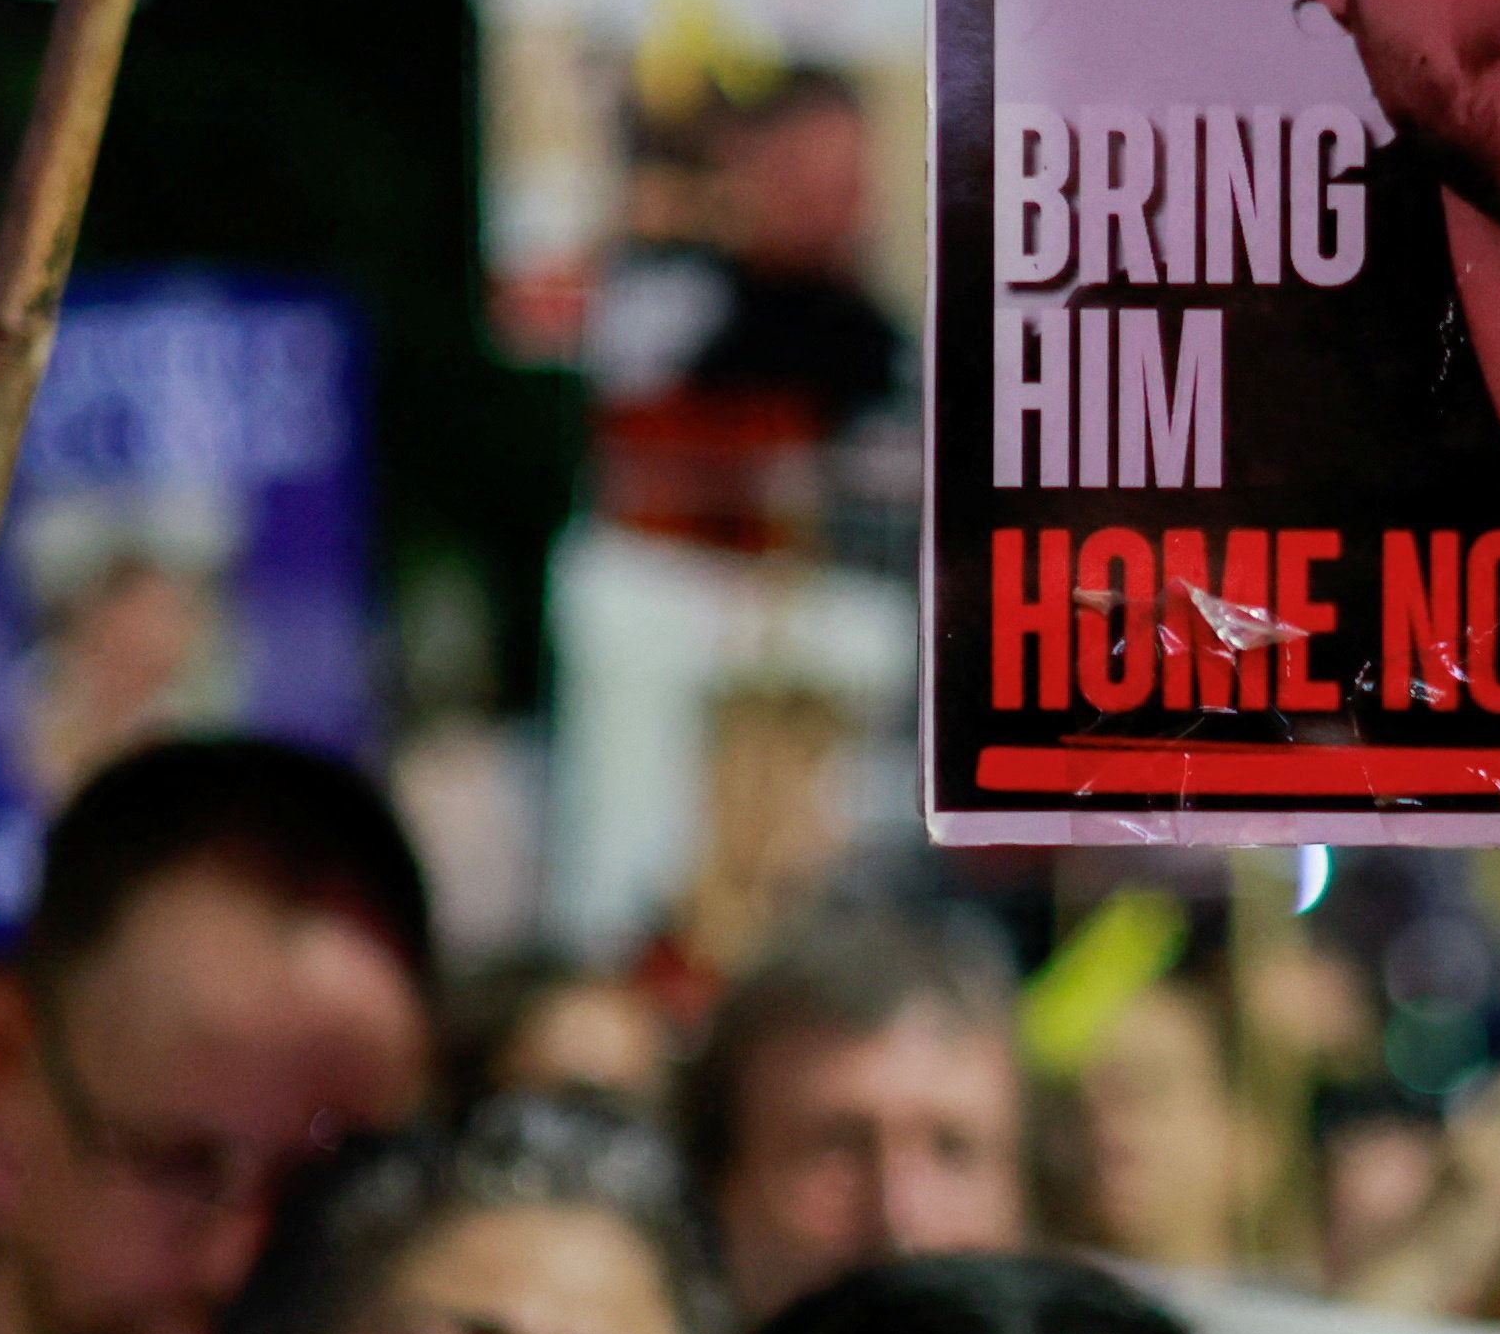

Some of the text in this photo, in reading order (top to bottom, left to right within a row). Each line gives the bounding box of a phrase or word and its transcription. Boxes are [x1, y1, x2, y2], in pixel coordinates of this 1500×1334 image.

[993, 103, 1368, 287] BRING
[993, 307, 1224, 489] HIM
[991, 526, 1341, 715] HOME
